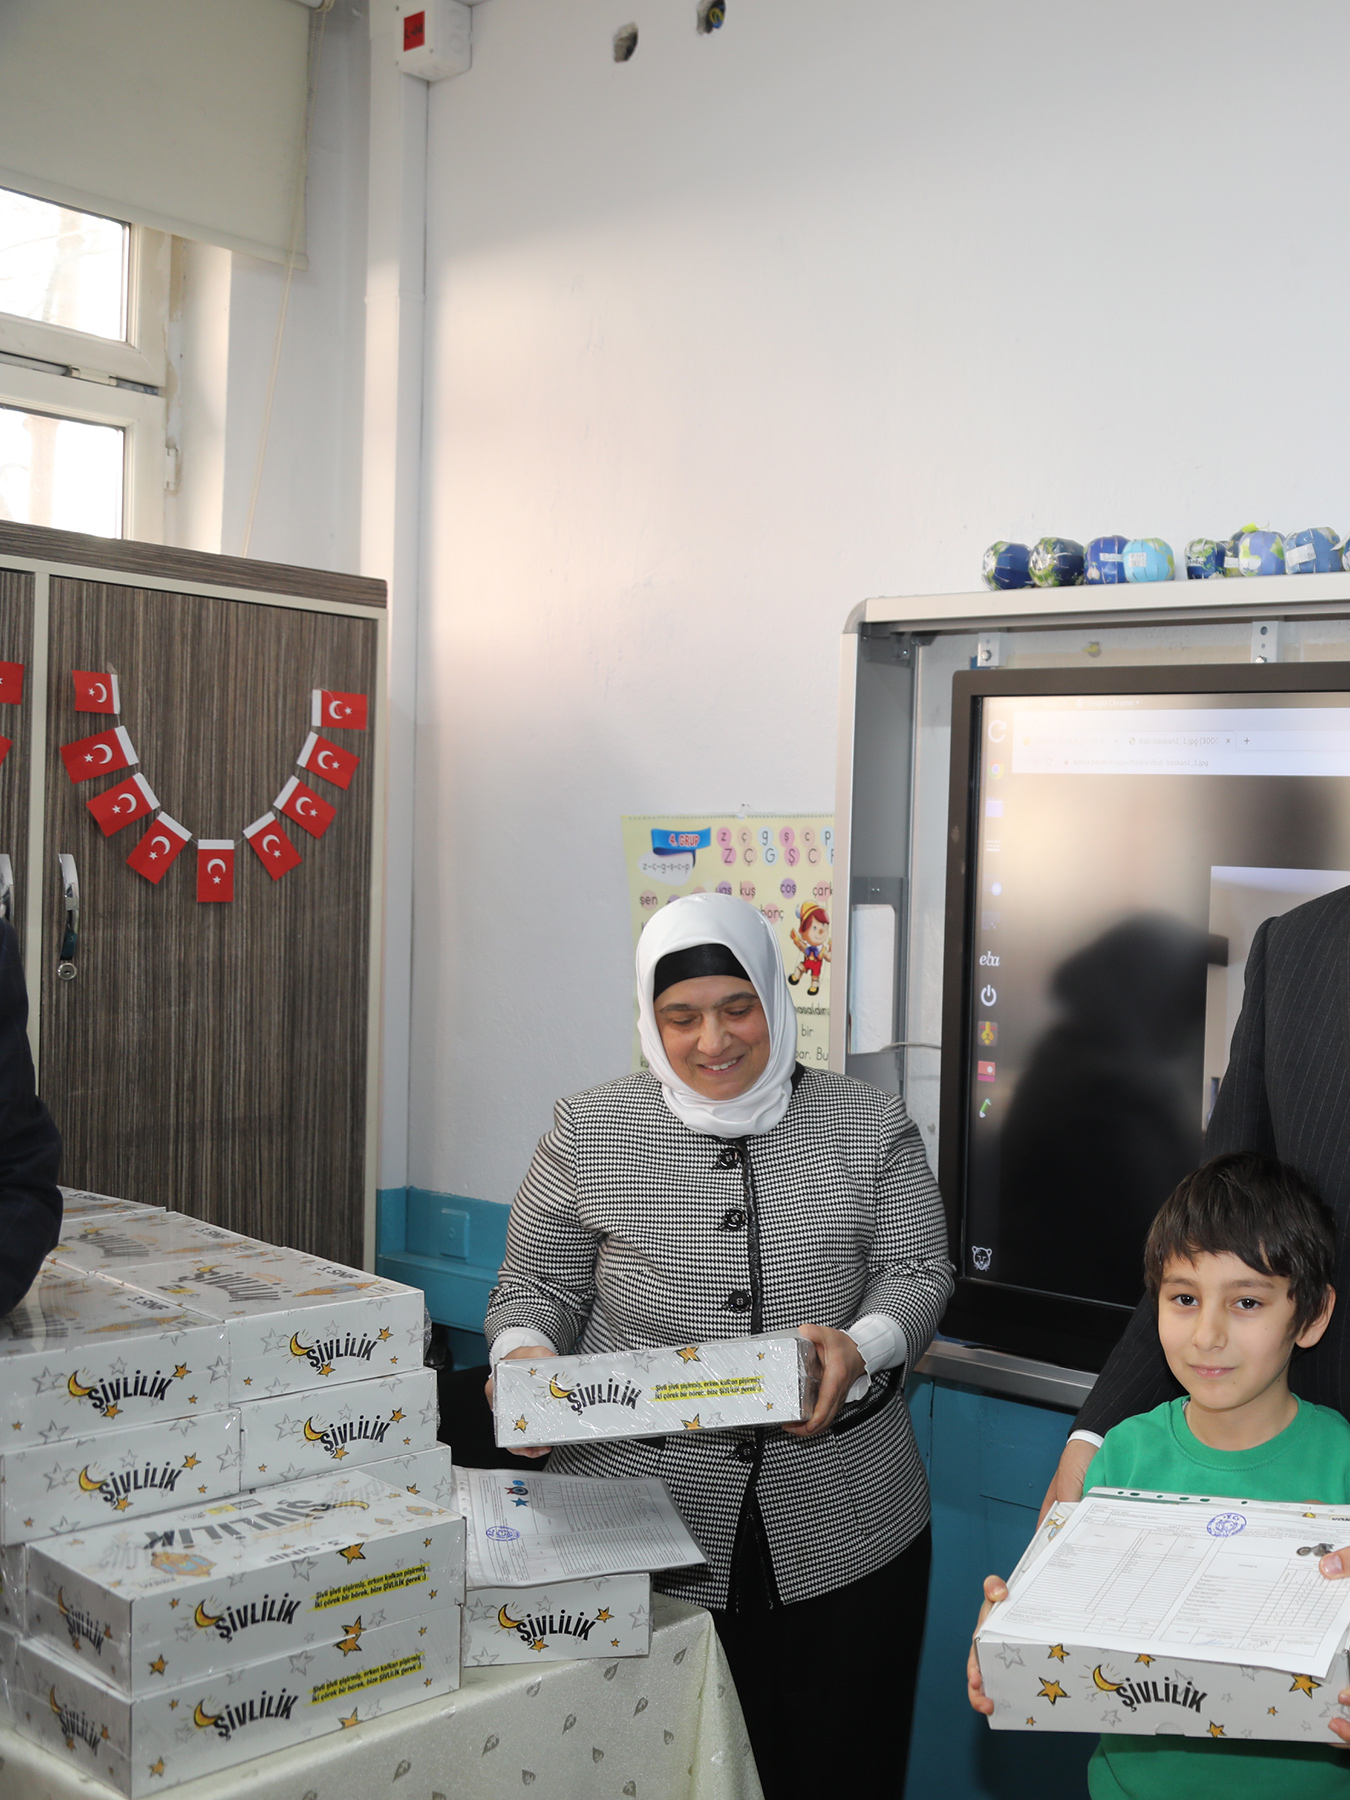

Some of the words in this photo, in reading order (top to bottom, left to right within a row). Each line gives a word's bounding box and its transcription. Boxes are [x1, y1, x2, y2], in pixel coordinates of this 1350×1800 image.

[678, 833, 700, 847] GRUP
[721, 832, 727, 842] z
[741, 832, 748, 844] ç
[761, 831, 769, 846] g
[783, 831, 790, 844] ş
[804, 831, 810, 842] c
[824, 830, 832, 846] p
[724, 848, 733, 864] Z
[743, 848, 754, 867] Ç
[765, 847, 776, 864] G
[788, 848, 796, 867] Ş
[807, 847, 818, 864] C
[740, 881, 756, 899] kuş
[780, 883, 797, 896] coş
[640, 895, 659, 908] şen
[979, 952, 1001, 967] eba
[796, 1002, 831, 1016] asaldır.
[801, 1023, 814, 1037] bir
[816, 1046, 829, 1061] Bu
[308, 1331, 378, 1374] ŞİVLİLİK
[90, 1368, 174, 1414] ŞİVLİLİK
[569, 1377, 643, 1417] ŞİVLİLİK
[320, 1415, 392, 1457] ŞİVLİLİK
[102, 1461, 184, 1507] ŞİVLİLİK
[341, 1593, 349, 1601] bir
[370, 1585, 382, 1593] bize
[405, 1576, 421, 1586] gerek
[368, 1576, 384, 1586] erken
[216, 1592, 303, 1643] ŞİVLİLİK
[517, 1606, 597, 1649] ŞİVLİLİK
[338, 1687, 346, 1695] bir
[1116, 1676, 1209, 1714] ŞİVLİLİK
[216, 1686, 300, 1743] ŞİVLİLİK
